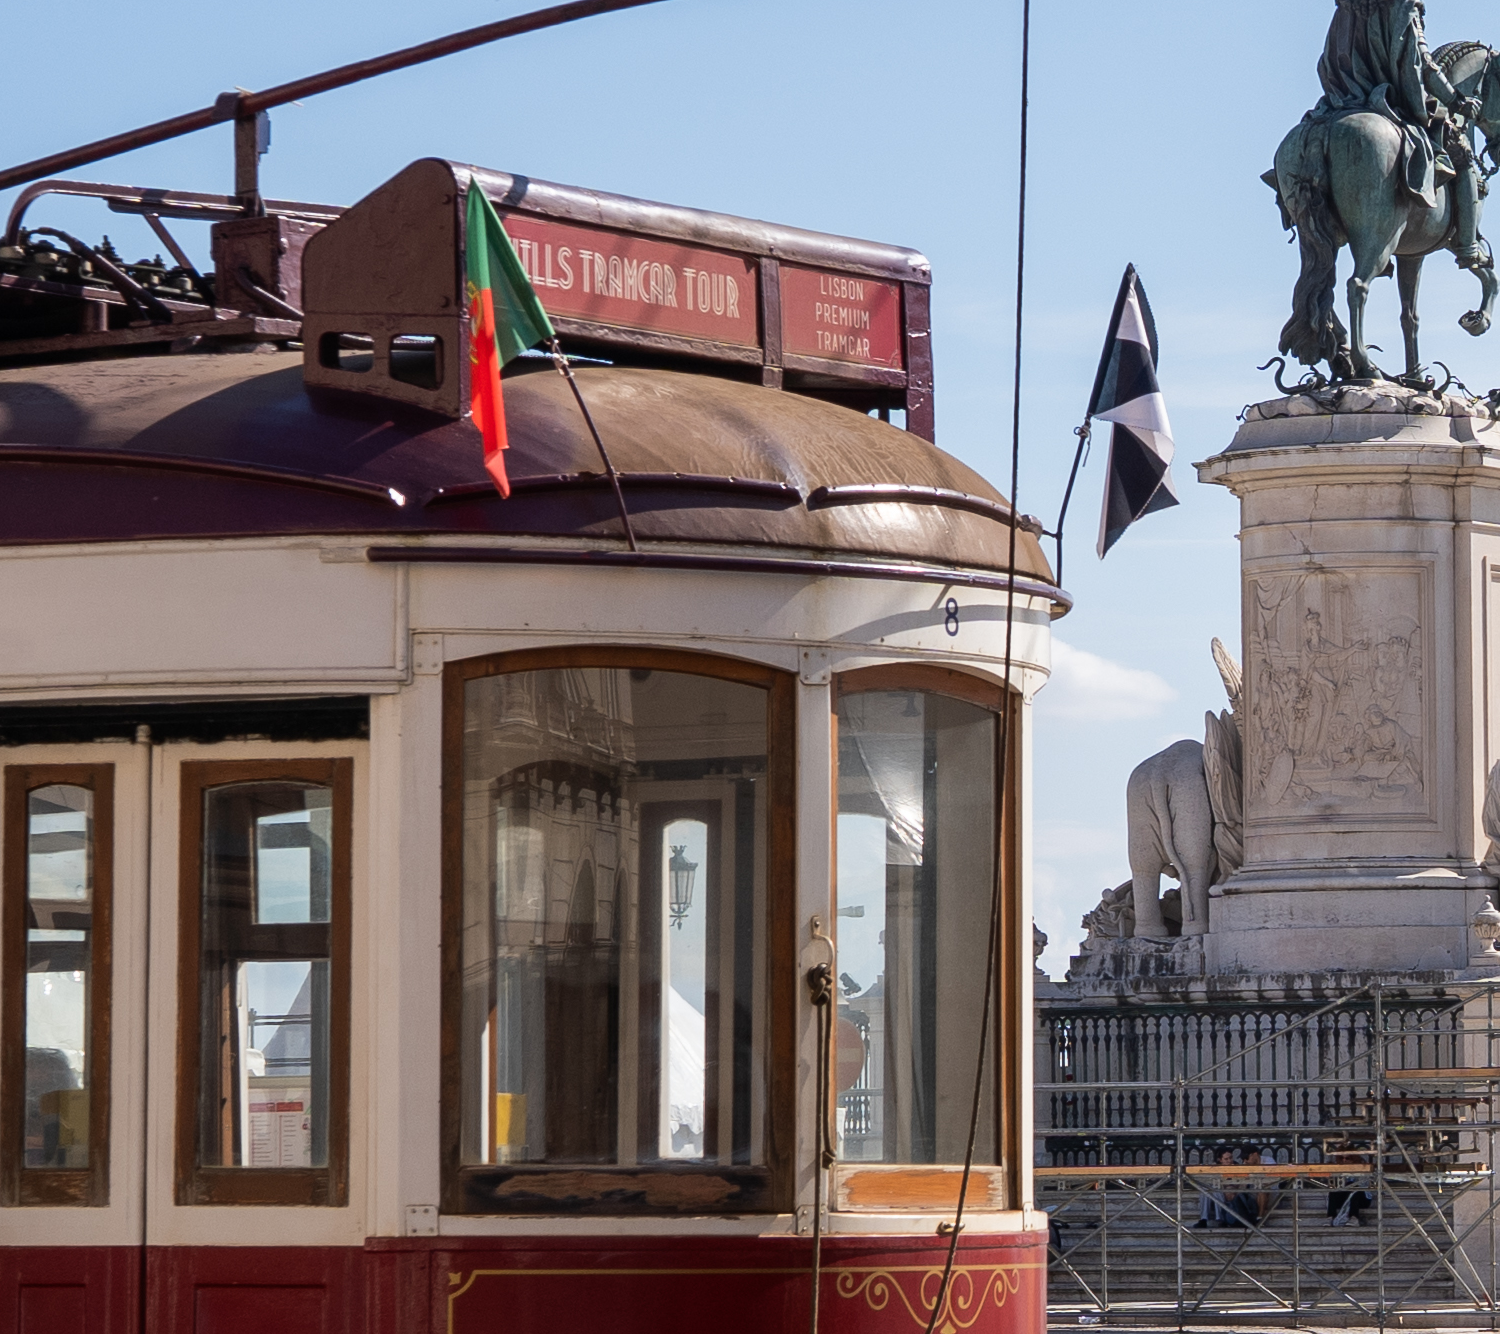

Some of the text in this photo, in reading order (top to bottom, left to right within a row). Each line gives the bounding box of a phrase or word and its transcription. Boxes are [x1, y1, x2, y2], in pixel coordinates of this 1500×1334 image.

[579, 250, 678, 308] TRAMCAR
[683, 267, 740, 319] TOUR
[820, 275, 864, 301] LISBON
[815, 302, 870, 330] PREMIUM
[816, 331, 871, 358] TRAMCAR
[945, 597, 959, 637] 8
